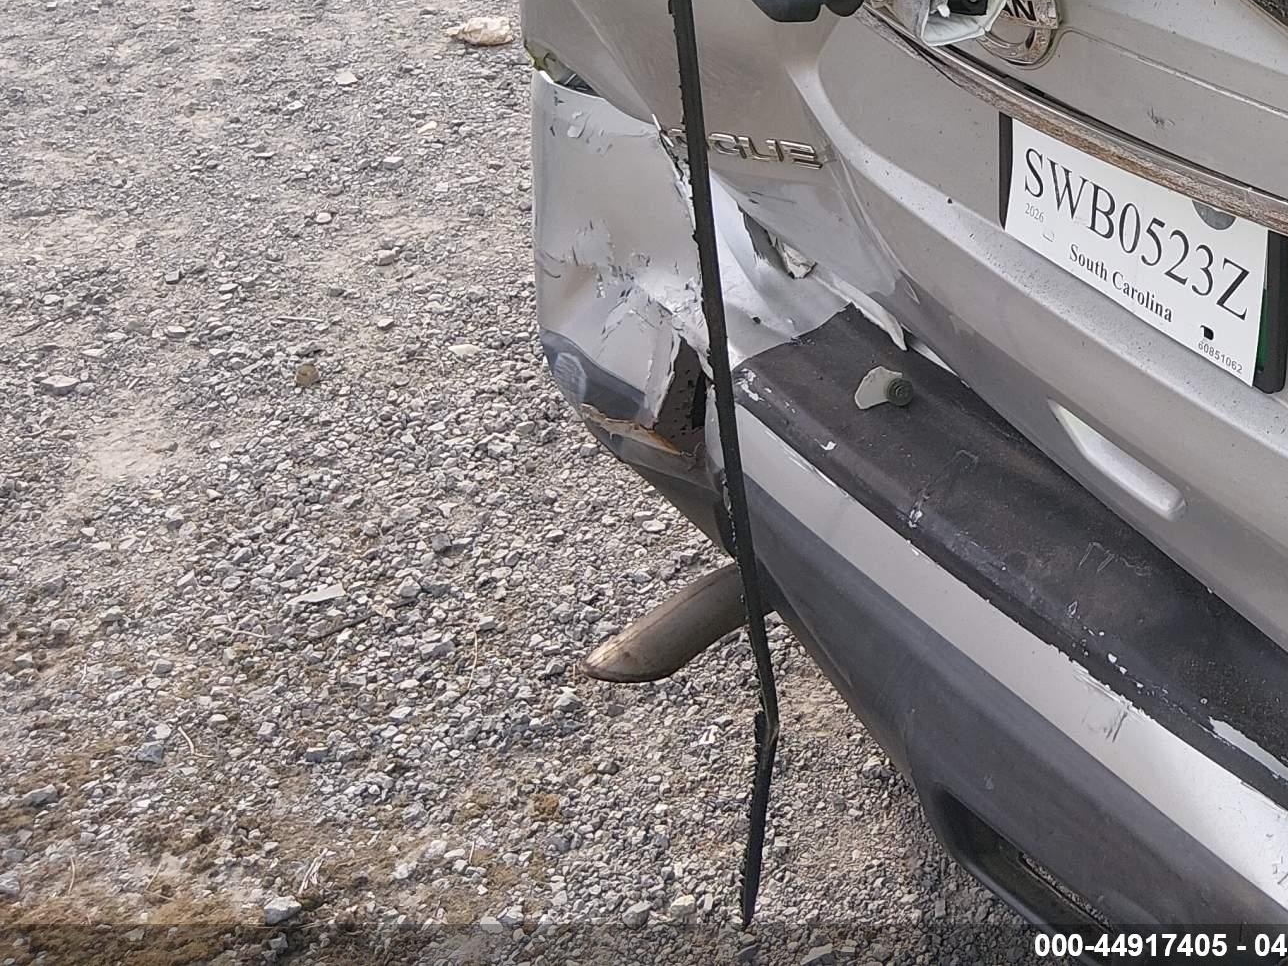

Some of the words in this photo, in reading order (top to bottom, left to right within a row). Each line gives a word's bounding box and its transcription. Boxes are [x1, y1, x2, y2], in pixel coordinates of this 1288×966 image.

[1023, 147, 1250, 321] SWB0523Z
[1024, 202, 1045, 223] 2026
[1068, 243, 1108, 282] South
[1112, 272, 1173, 323] Carolina
